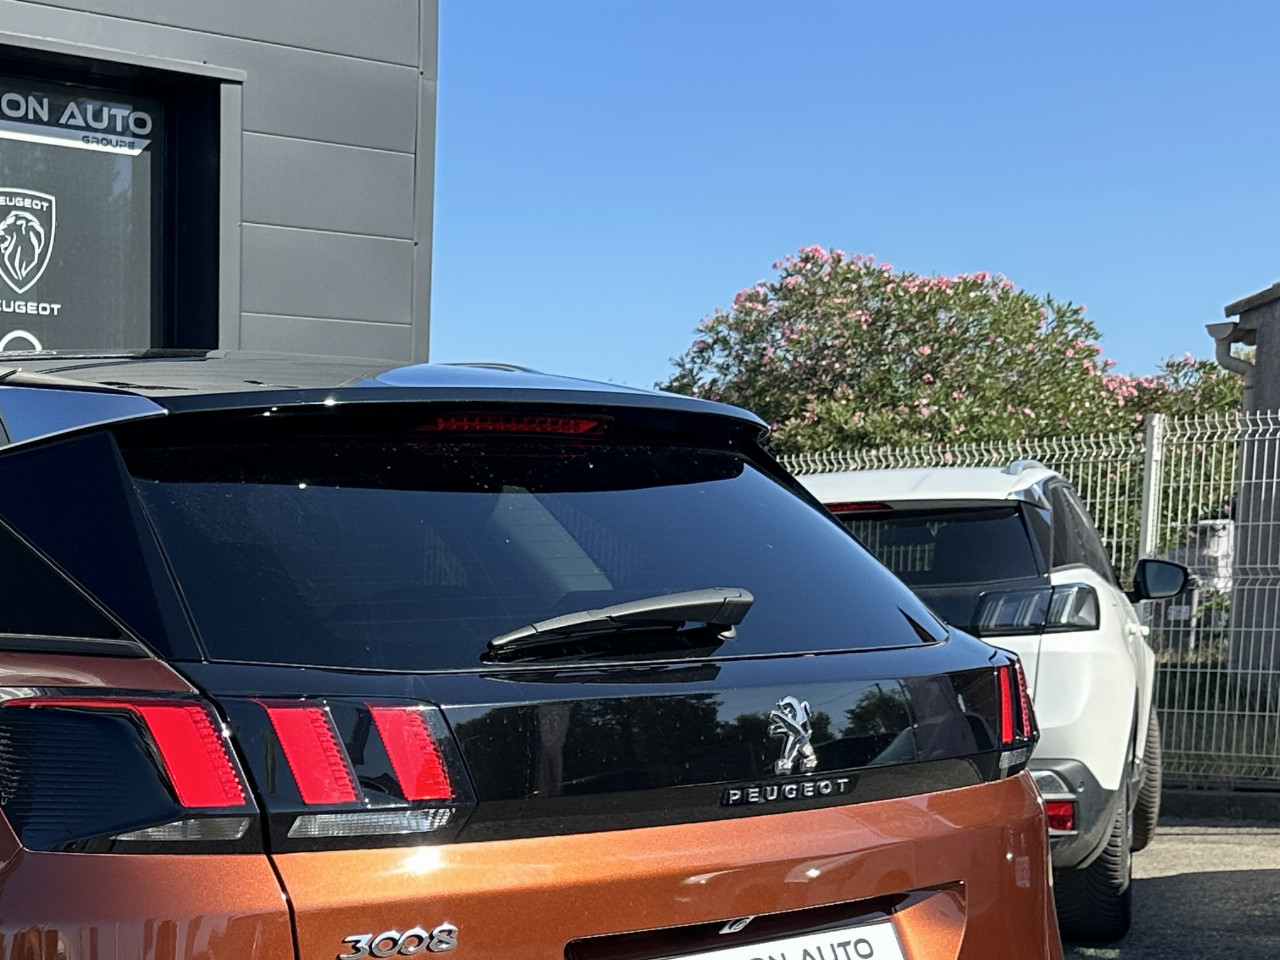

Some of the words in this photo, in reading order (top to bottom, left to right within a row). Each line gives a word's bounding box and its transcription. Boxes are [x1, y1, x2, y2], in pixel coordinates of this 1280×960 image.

[58, 100, 153, 135] AUTO
[81, 134, 137, 150] GROUPE
[726, 778, 849, 804] PEUGEOT
[337, 922, 458, 960] 3008
